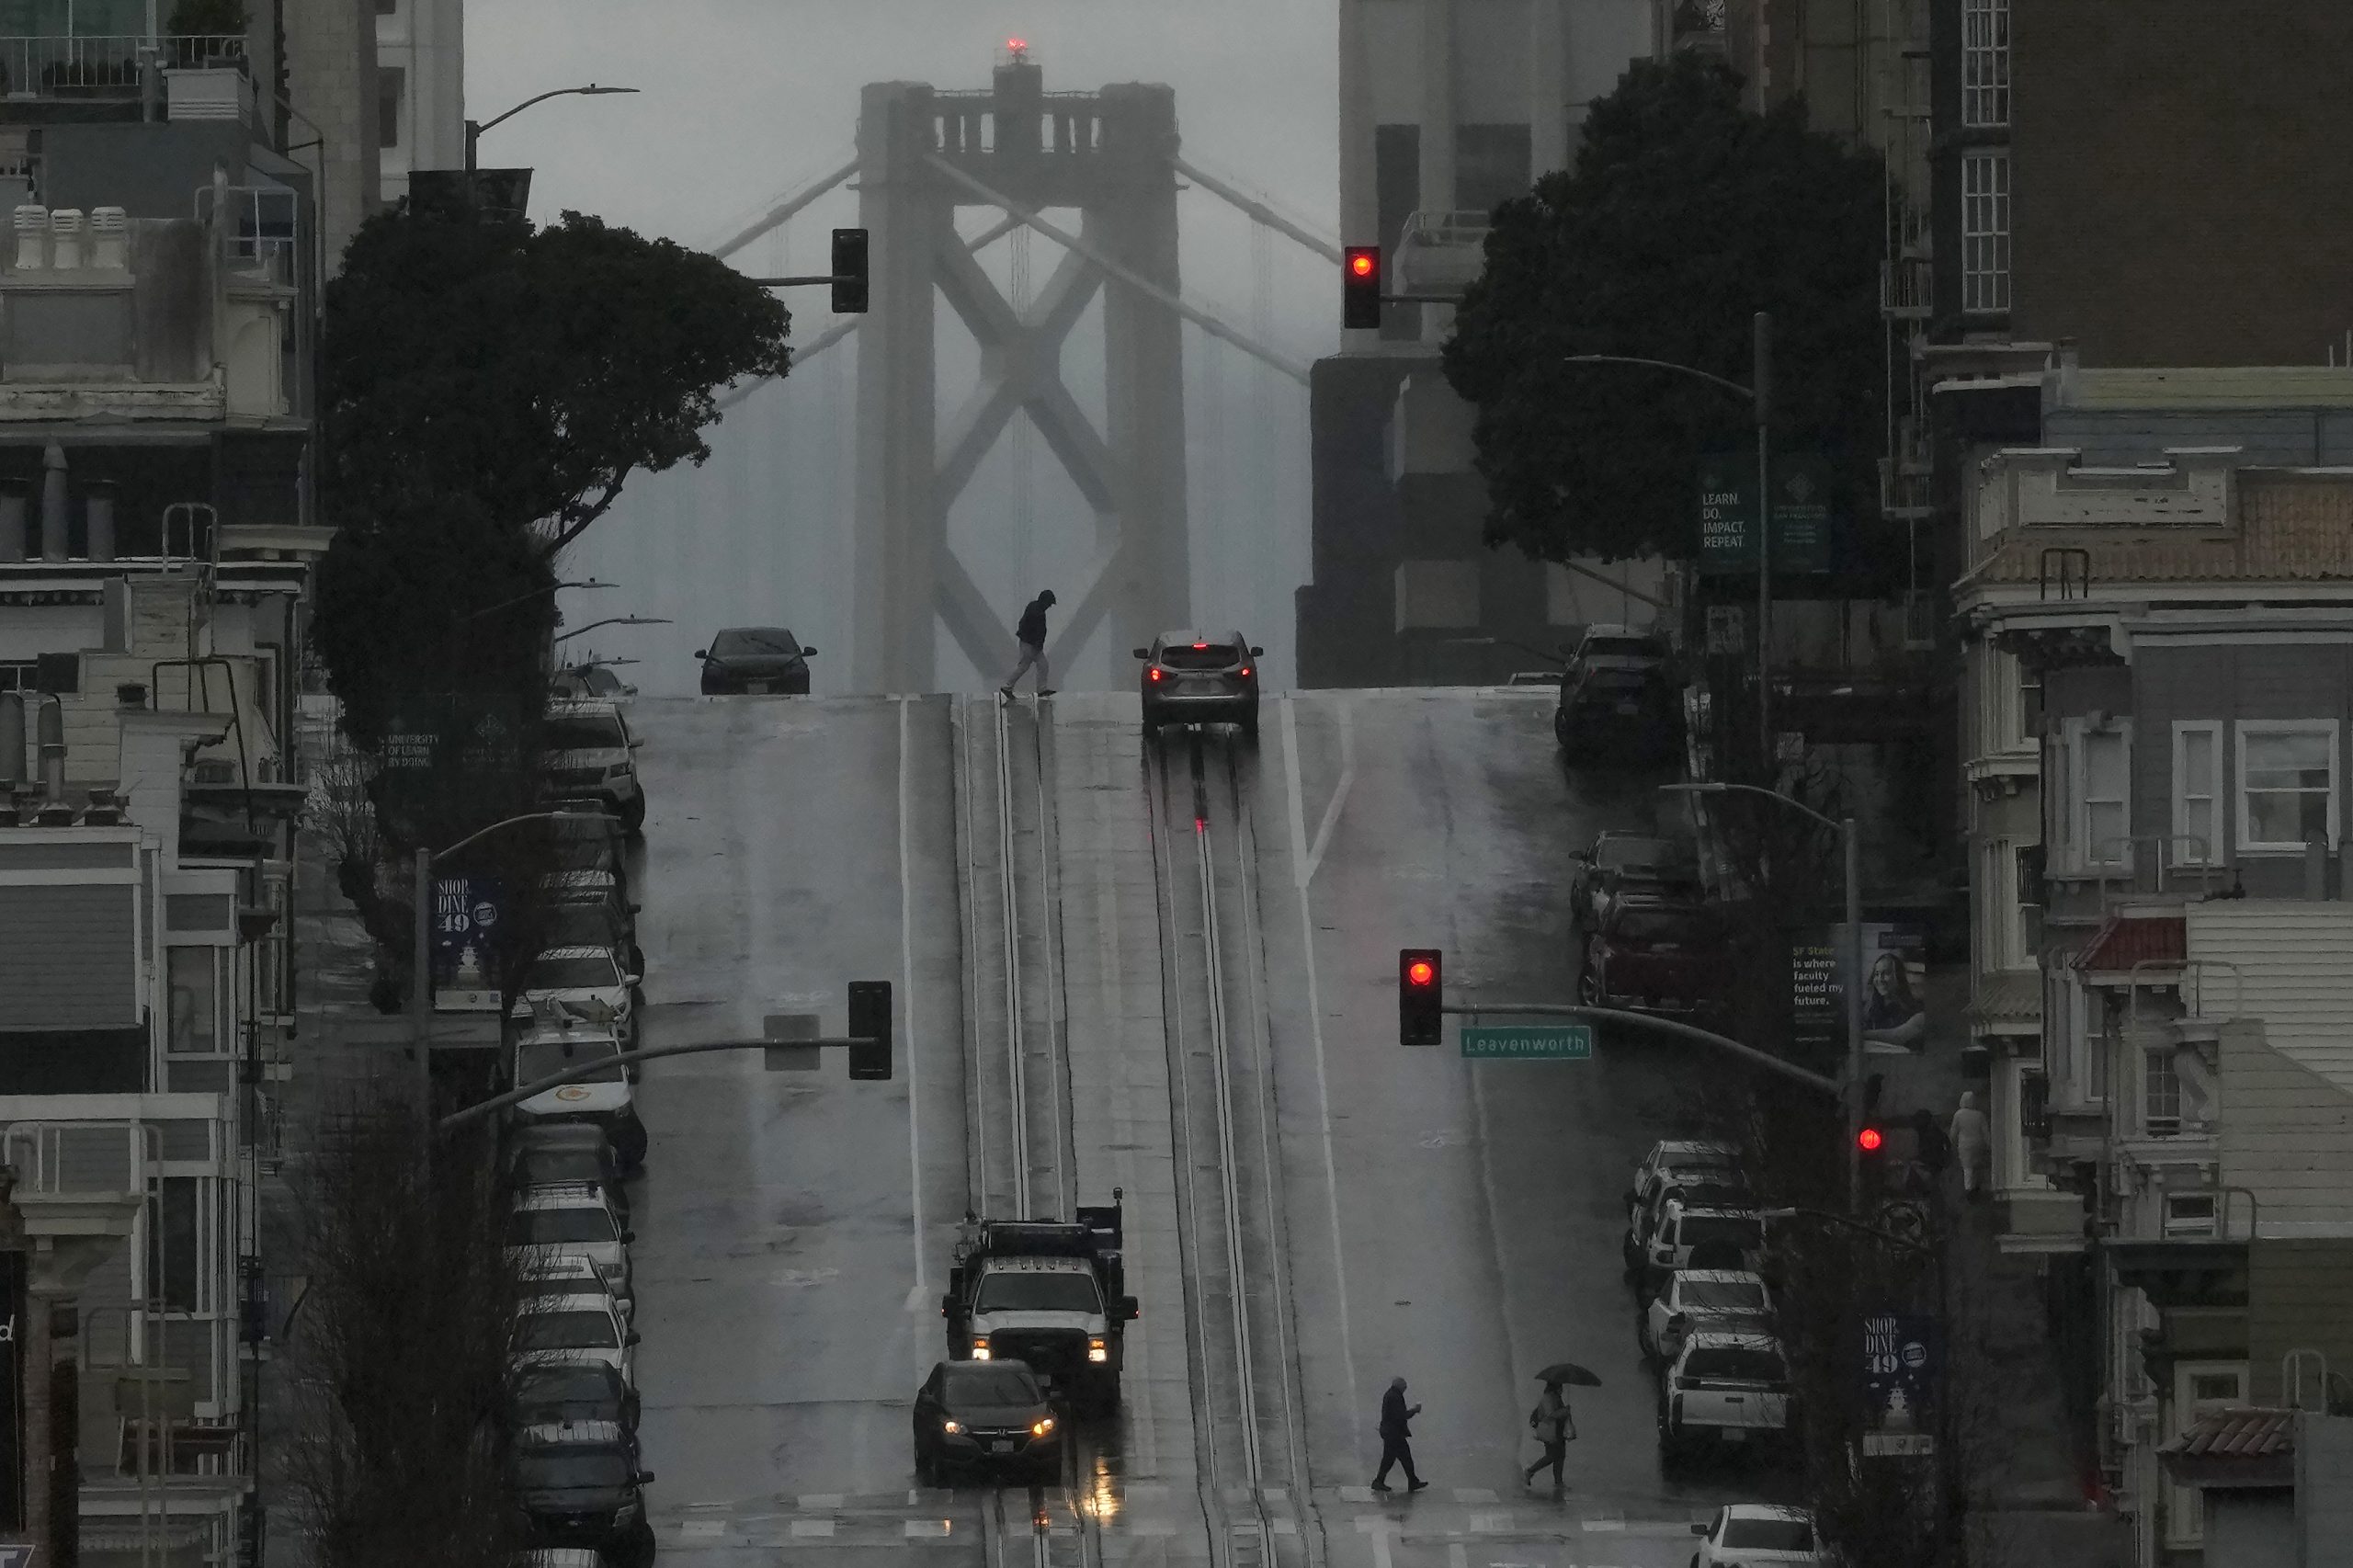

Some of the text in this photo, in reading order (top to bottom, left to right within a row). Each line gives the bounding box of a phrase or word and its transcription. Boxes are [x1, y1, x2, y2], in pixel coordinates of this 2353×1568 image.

[1702, 493, 1741, 506] LEARN.
[1703, 508, 1722, 520] DO.
[1703, 521, 1746, 534] IMPACT.
[438, 879, 469, 895] SHOP
[438, 895, 469, 914] DINE
[438, 914, 470, 933] 49
[1792, 947, 1835, 956] SF State
[1792, 958, 1836, 969] is where
[1793, 970, 1829, 982] faculty
[1793, 983, 1844, 994] fueled my
[1793, 995, 1830, 1006] future.
[1466, 1036, 1585, 1052] Leavenworth
[1864, 1317, 1896, 1335] SHOP
[1866, 1335, 1897, 1354] DINE
